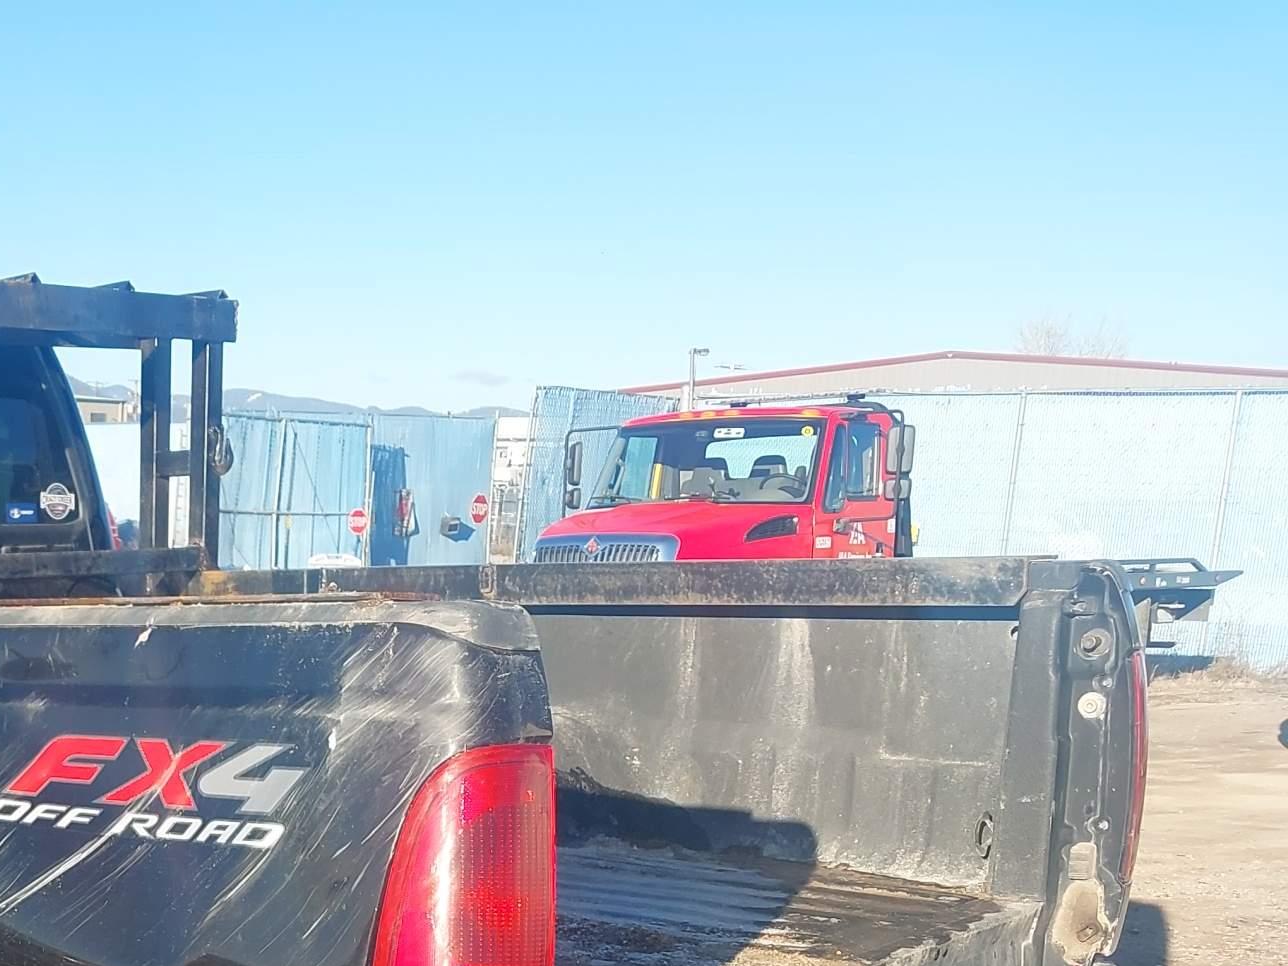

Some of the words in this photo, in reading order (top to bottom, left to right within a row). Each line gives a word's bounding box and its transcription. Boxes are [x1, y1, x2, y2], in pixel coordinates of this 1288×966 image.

[350, 516, 367, 527] STOP
[473, 503, 488, 515] STOP
[5, 733, 307, 816] FX4
[112, 811, 286, 849] ROAD
